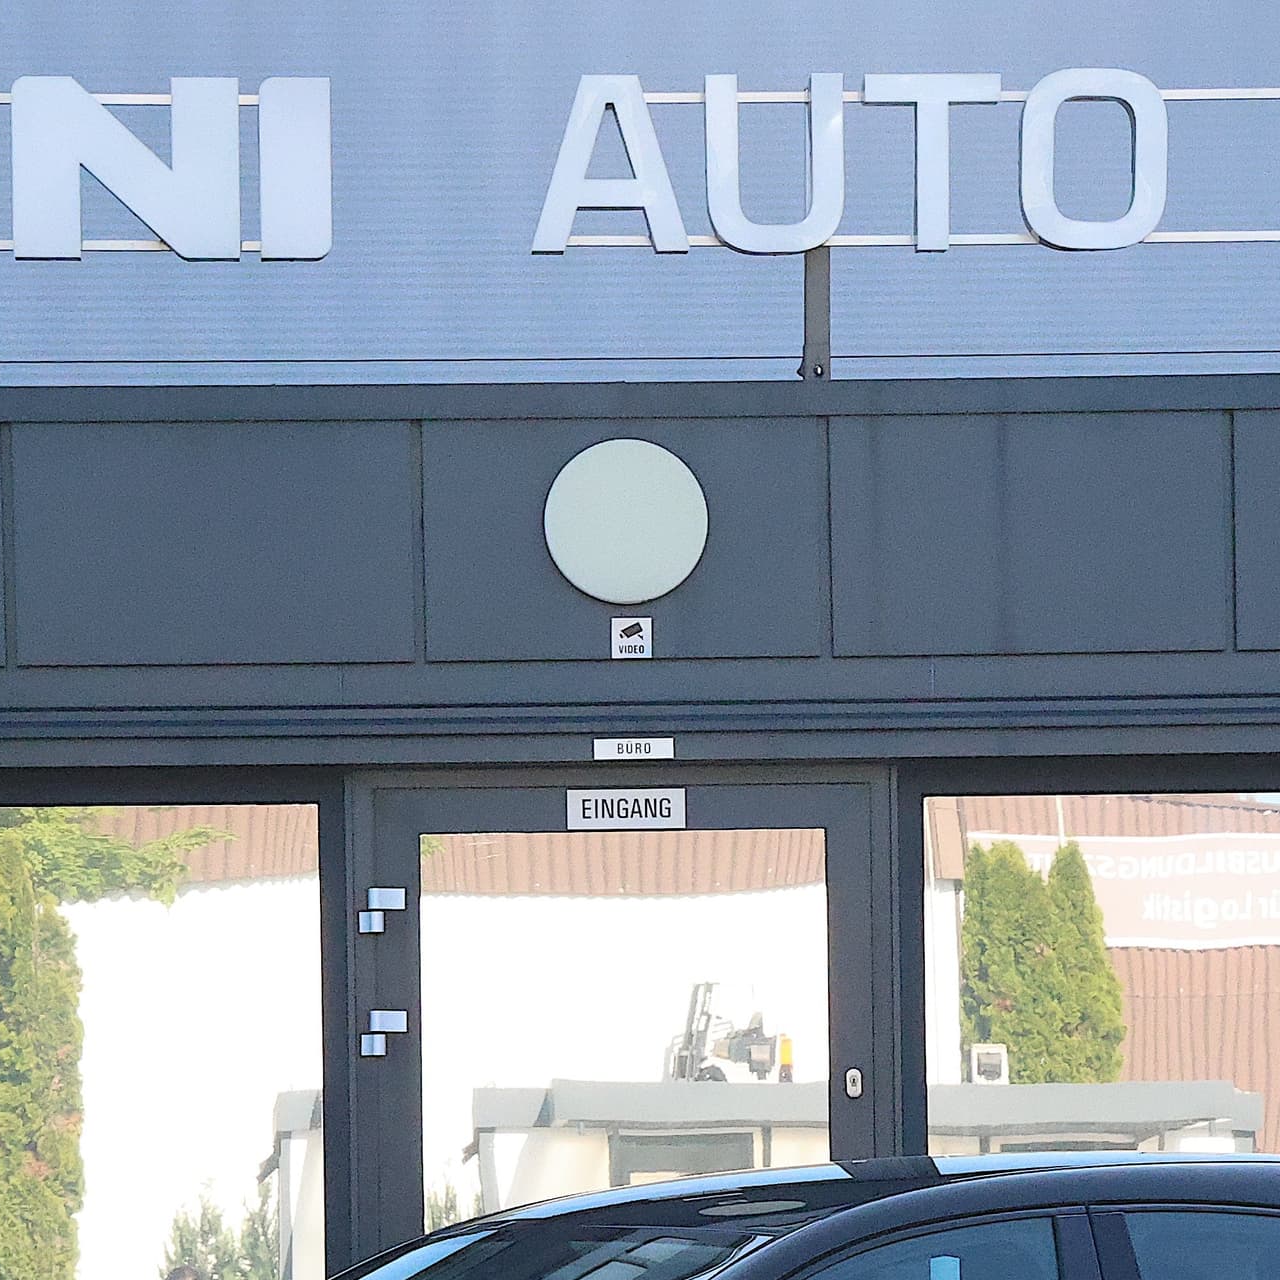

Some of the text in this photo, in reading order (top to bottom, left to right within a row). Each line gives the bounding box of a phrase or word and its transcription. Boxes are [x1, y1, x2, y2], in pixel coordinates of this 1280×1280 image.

[530, 65, 1169, 255] AUTO
[618, 644, 645, 655] VIDEO
[581, 797, 672, 819] EINGANG
